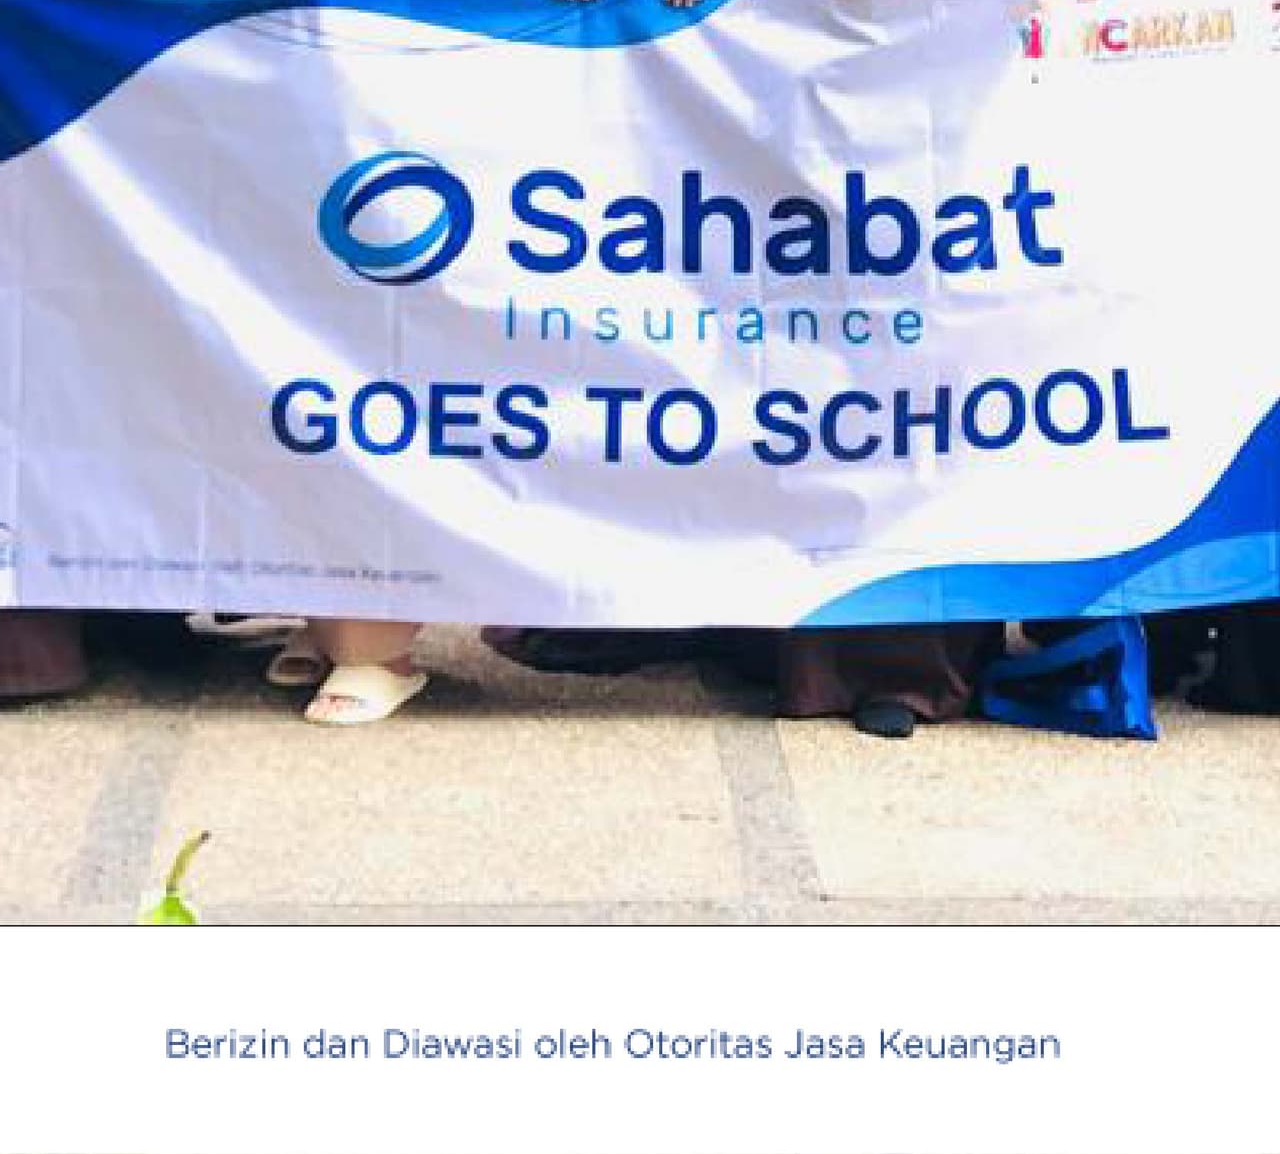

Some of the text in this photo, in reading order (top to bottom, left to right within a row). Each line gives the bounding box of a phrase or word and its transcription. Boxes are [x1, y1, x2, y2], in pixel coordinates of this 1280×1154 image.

[507, 164, 1064, 275] Sahabat
[505, 297, 924, 345] Insurance
[270, 368, 1171, 466] GOES TO SCHOOL
